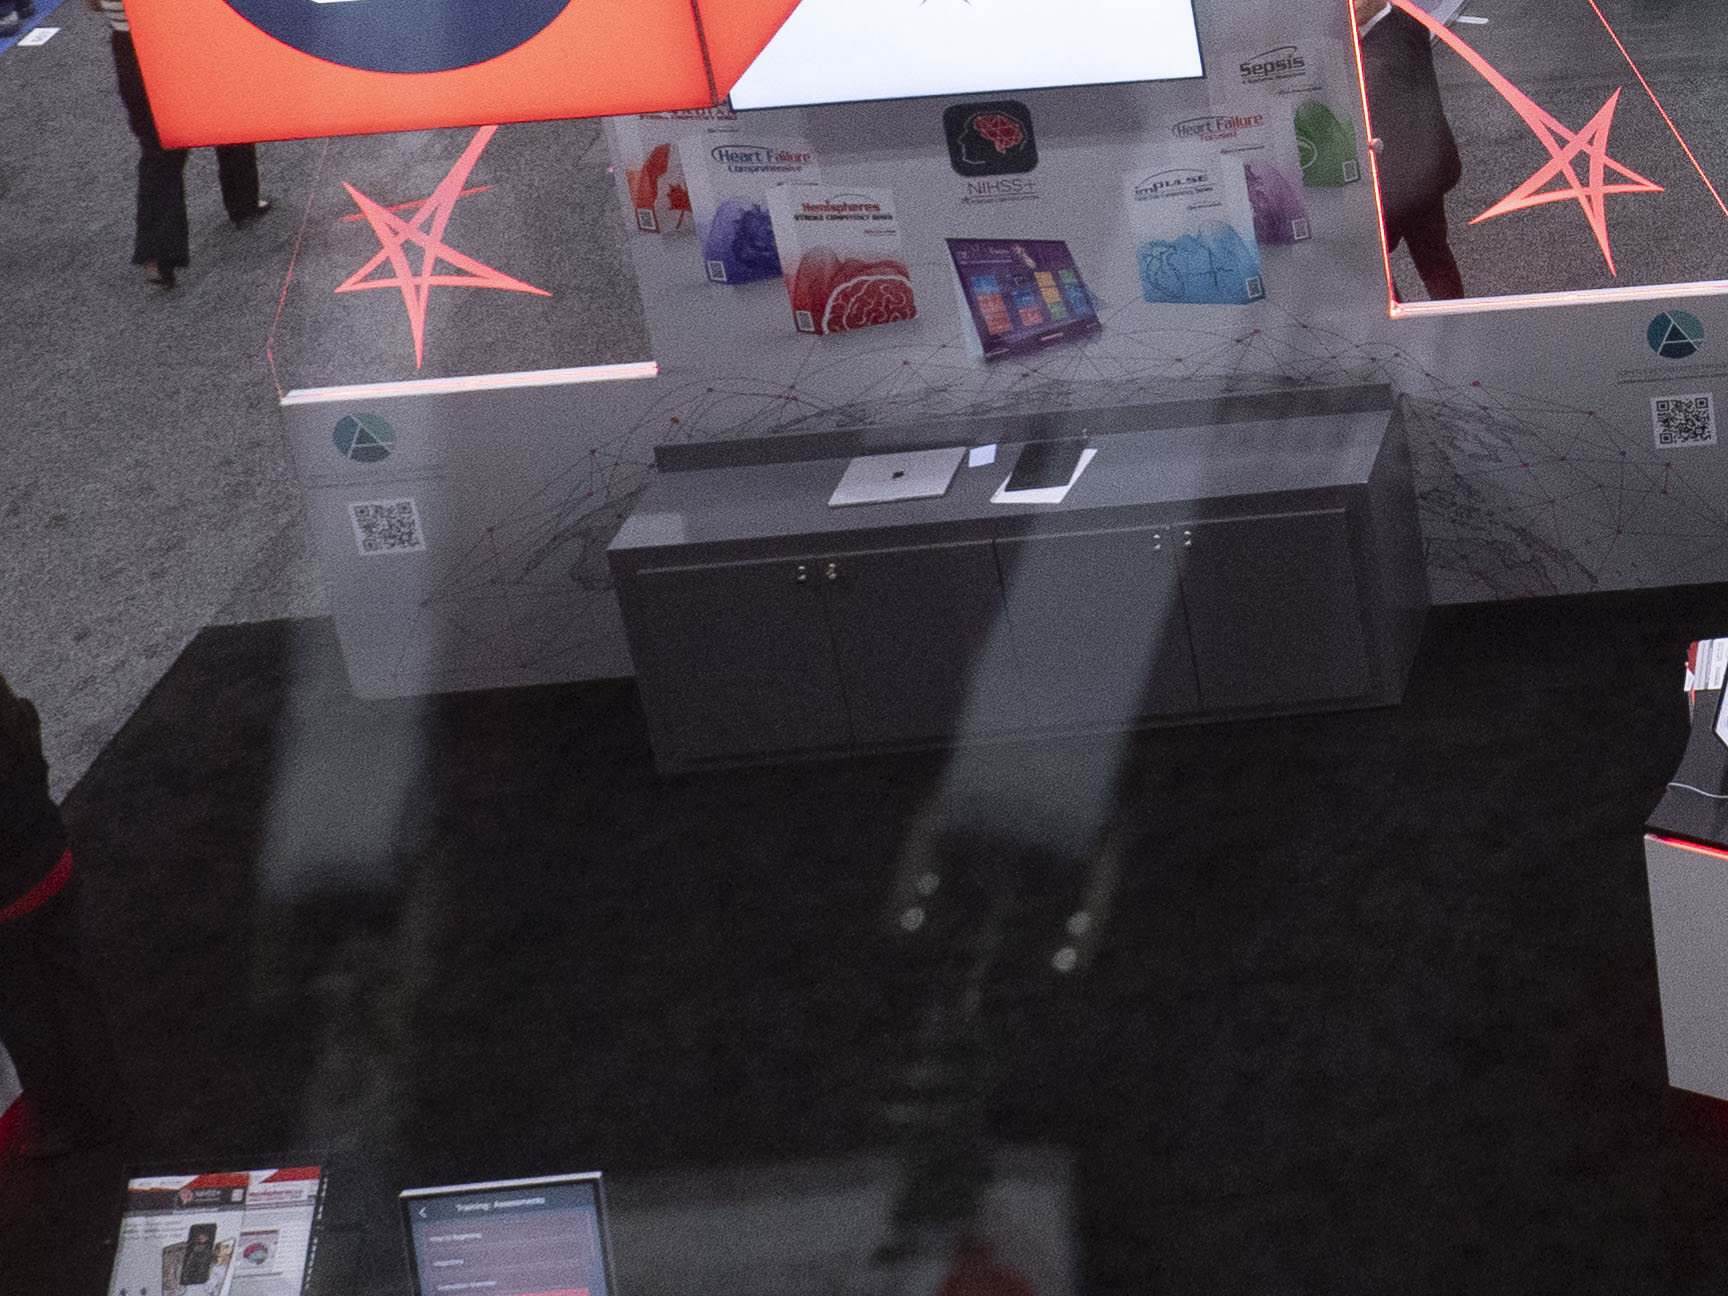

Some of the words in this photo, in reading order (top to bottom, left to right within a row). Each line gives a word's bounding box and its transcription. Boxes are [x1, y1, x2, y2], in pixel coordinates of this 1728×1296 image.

[1239, 54, 1306, 79] Sepsis
[1176, 119, 1213, 139] Heart
[1215, 113, 1263, 132] Failure
[717, 149, 762, 165] Heart
[765, 148, 812, 164] Failure
[727, 163, 803, 174] Comprehensive
[966, 178, 1038, 197] NIHSS+
[801, 199, 882, 215] Hemispheres
